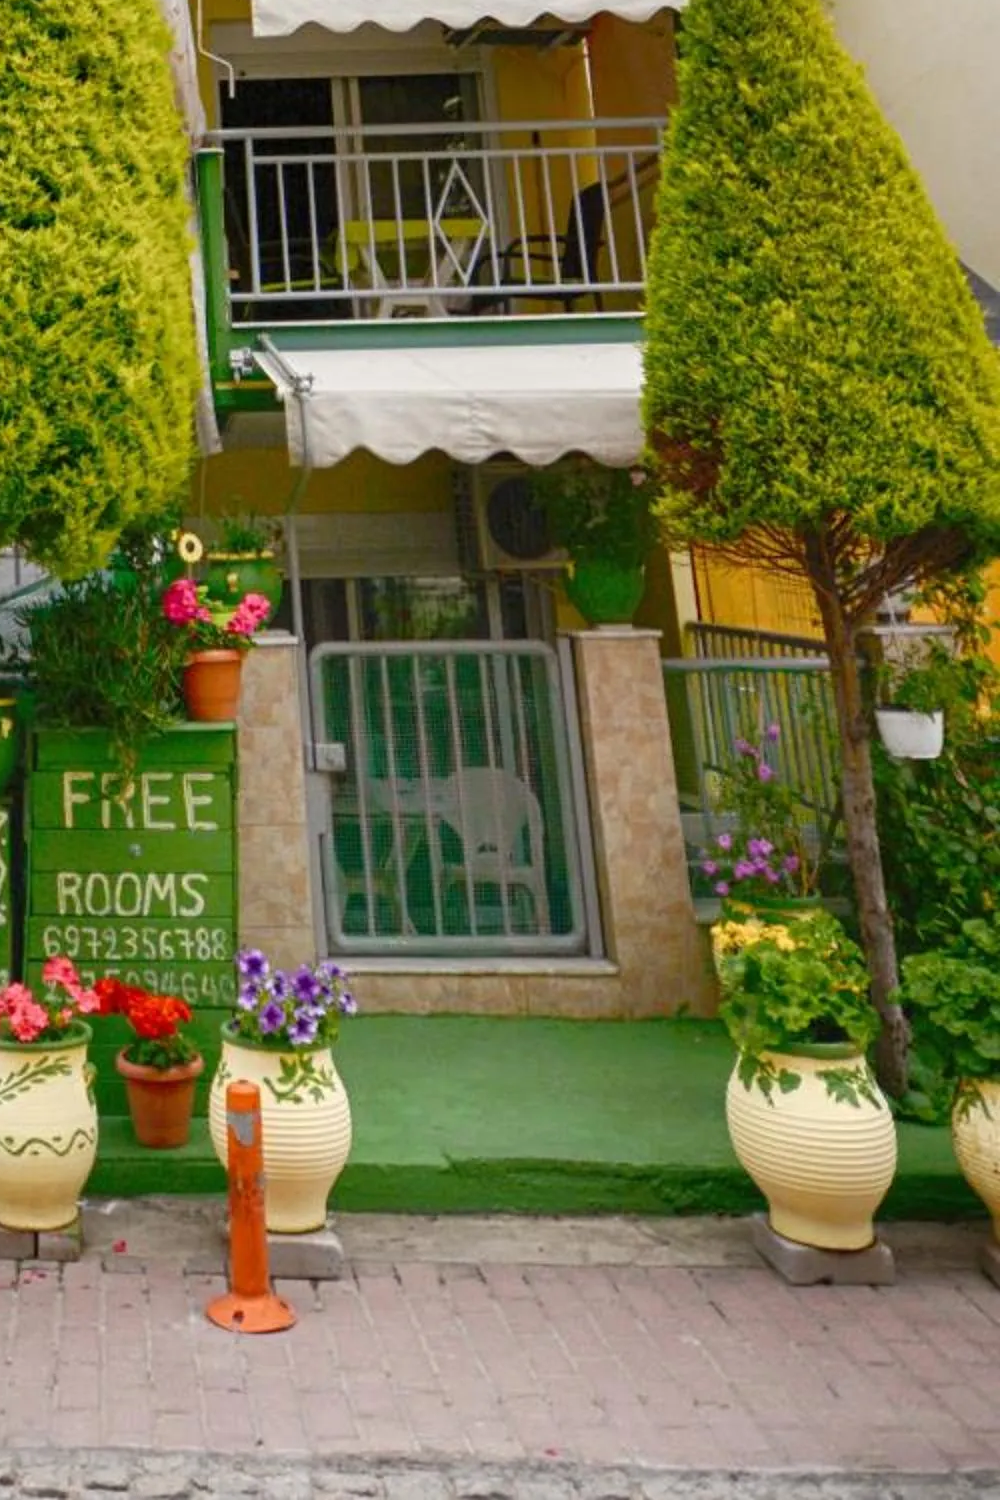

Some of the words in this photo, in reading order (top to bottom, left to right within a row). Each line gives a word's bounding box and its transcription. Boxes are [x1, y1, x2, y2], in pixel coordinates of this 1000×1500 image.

[62, 772, 219, 830] FREE
[57, 873, 209, 917] ROOMS
[43, 925, 228, 960] 6972356788
